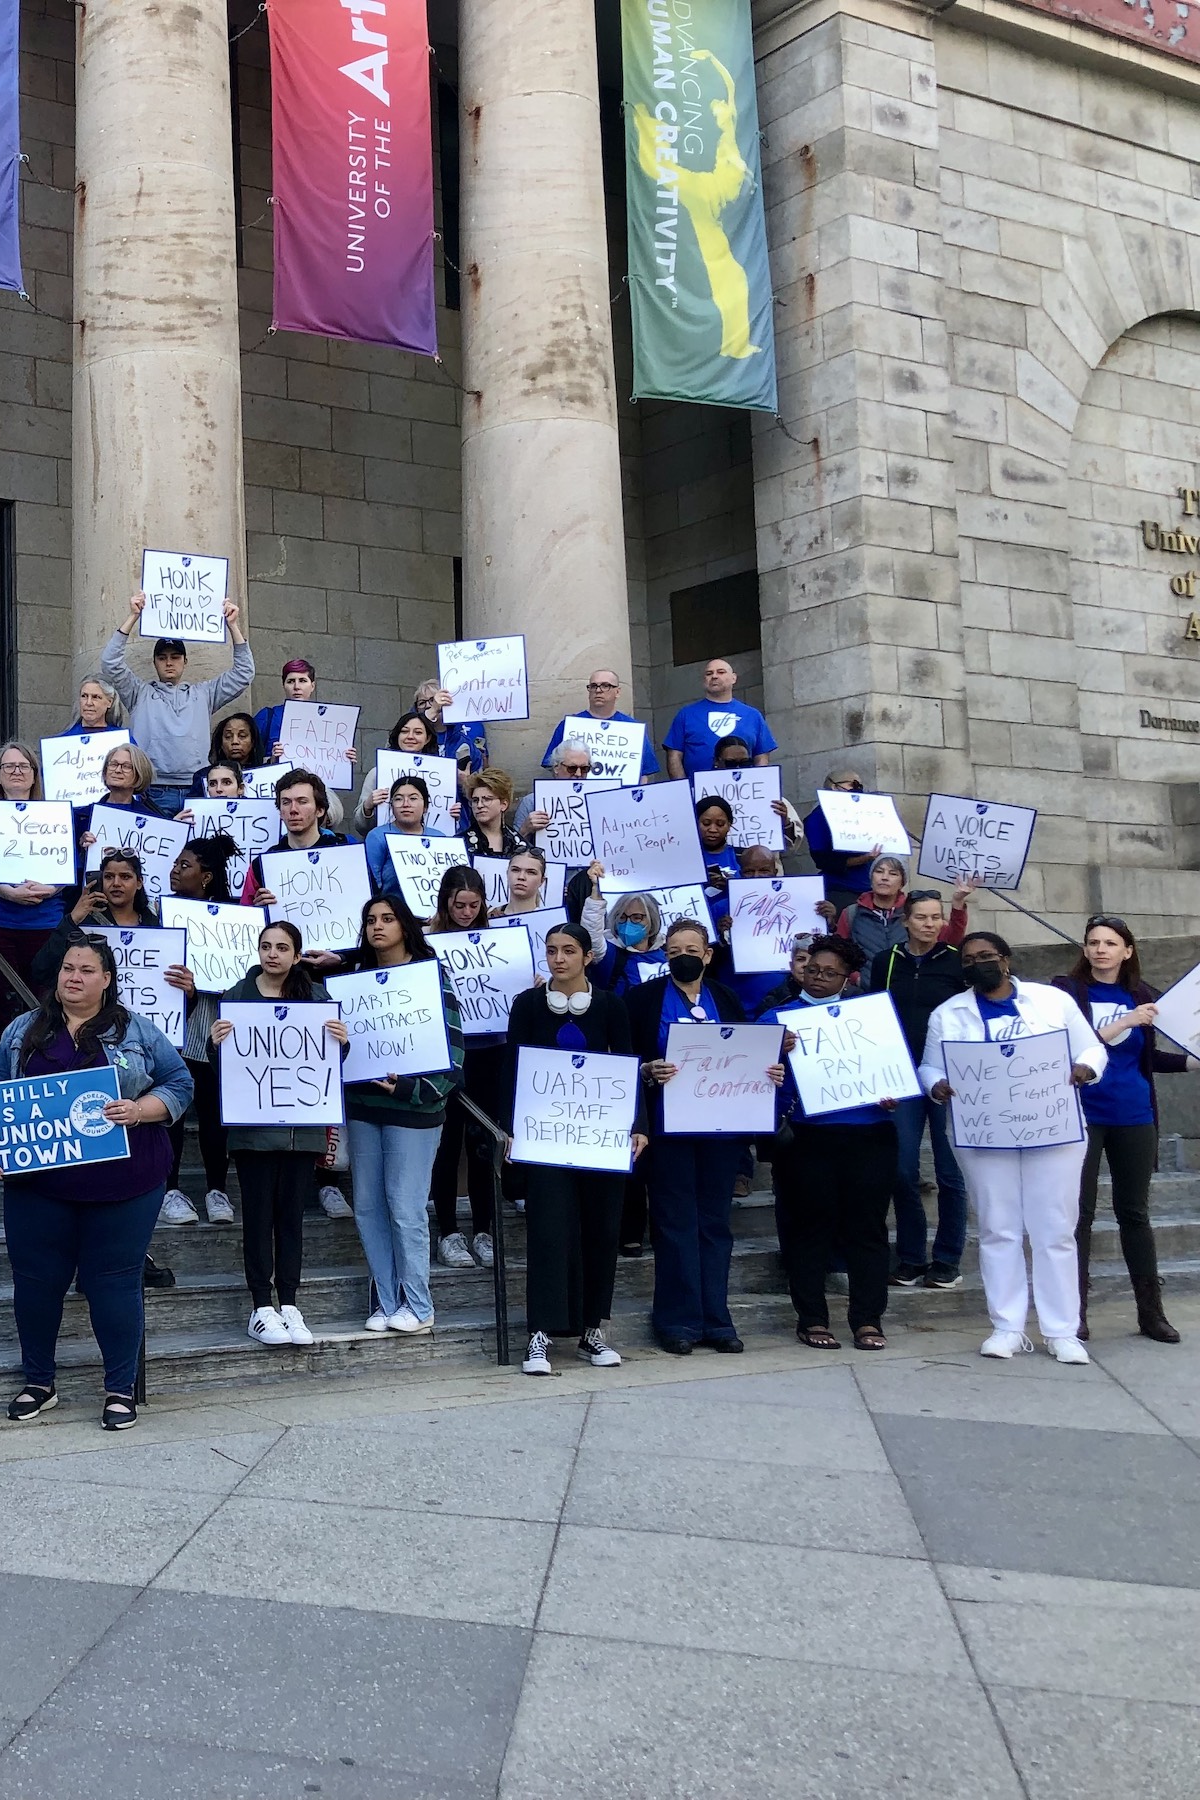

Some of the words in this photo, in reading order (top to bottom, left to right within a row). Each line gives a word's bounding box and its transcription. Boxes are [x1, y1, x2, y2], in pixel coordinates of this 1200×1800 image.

[374, 118, 391, 168] THE
[346, 110, 367, 272] UNIVERSITY
[374, 180, 391, 219] OF
[160, 566, 214, 593] HONK
[1170, 569, 1197, 598] of
[150, 593, 162, 609] IF
[159, 613, 223, 634] UNIONS!
[441, 667, 523, 698] Contract
[465, 699, 513, 717] NOW!
[289, 718, 348, 745] FAIR
[568, 730, 629, 747] SHARED
[53, 750, 104, 768] Adjun
[282, 743, 351, 763] CONTRAC
[592, 748, 640, 759] RNANCE
[591, 762, 627, 776] OW!
[717, 781, 765, 801] VOICE
[543, 795, 586, 820] UAR
[10, 814, 70, 835] Years
[545, 821, 590, 838] STAF
[931, 812, 947, 830] A
[954, 814, 1015, 842] VOICE
[96, 824, 108, 841] A
[117, 827, 175, 858] VOICE
[550, 841, 593, 858] UNIO
[727, 830, 774, 849] TAFF!
[954, 837, 978, 851] FOR
[3, 839, 24, 859] 2
[29, 841, 68, 865] Long
[431, 850, 469, 866] YEARS
[603, 845, 625, 858] Are
[934, 845, 1001, 871] UARTS
[279, 866, 343, 897] HONK
[427, 867, 441, 876] IS
[283, 898, 332, 921] FOR
[417, 893, 438, 908] LO
[733, 891, 797, 917] FAIR
[172, 913, 261, 956] CONTRAC
[299, 917, 360, 945] NION
[752, 914, 798, 937] PAY
[113, 947, 160, 968] OICE
[117, 972, 135, 984] OR
[454, 974, 503, 997] FOR
[341, 990, 413, 1016] UARTS
[458, 993, 518, 1023] NION
[343, 1008, 432, 1037] CONTRACTS
[232, 1024, 326, 1061] UNION
[367, 1033, 414, 1060] NOW!
[796, 1018, 877, 1056] FAIR
[816, 1054, 864, 1079] PAY
[950, 1058, 999, 1082] WE
[1006, 1053, 1068, 1079] CARE!
[245, 1065, 332, 1110] YES!
[531, 1070, 626, 1100] UARTS
[957, 1087, 992, 1106] WE
[30, 1102, 44, 1120] A
[72, 1093, 112, 1112] PHILADELPHI
[548, 1101, 613, 1121] STAFF
[81, 1123, 112, 1134] COUNCIL
[960, 1112, 993, 1129] WE
[998, 1110, 1039, 1124] SHOW
[524, 1116, 632, 1149] REPRESENT
[964, 1132, 995, 1146] WE
[1009, 1117, 1070, 1142] VOTE!
